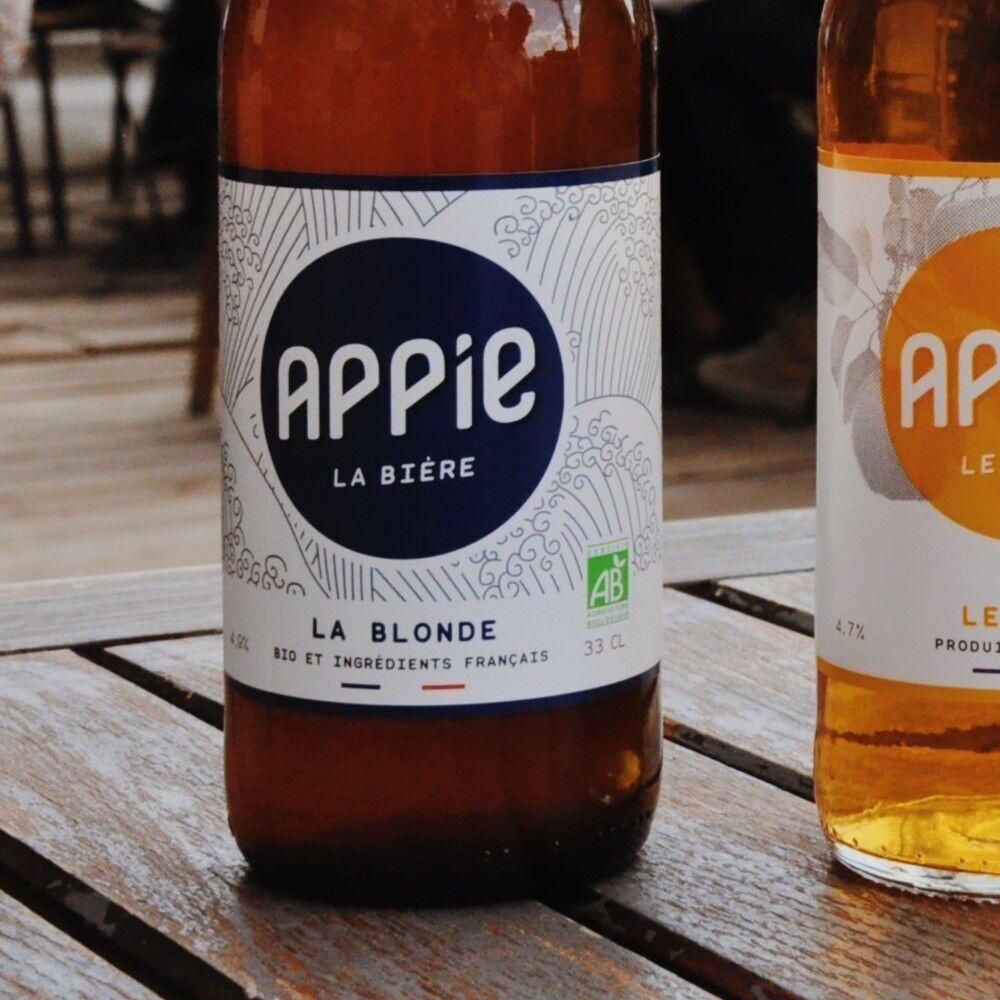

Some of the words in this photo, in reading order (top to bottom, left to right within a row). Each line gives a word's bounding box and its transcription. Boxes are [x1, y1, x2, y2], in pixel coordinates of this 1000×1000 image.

[960, 453, 996, 475] LE
[333, 467, 366, 487] LA
[590, 567, 625, 608] AB
[962, 605, 998, 627] LE
[312, 616, 346, 641] LA
[371, 619, 497, 643] BLONDE
[584, 638, 604, 656] 33
[610, 633, 626, 650] CL
[273, 647, 297, 662] BIO
[305, 652, 323, 665] ET
[334, 655, 452, 670] INGRÉDIENTS
[464, 650, 550, 667] FRANÇAIS
